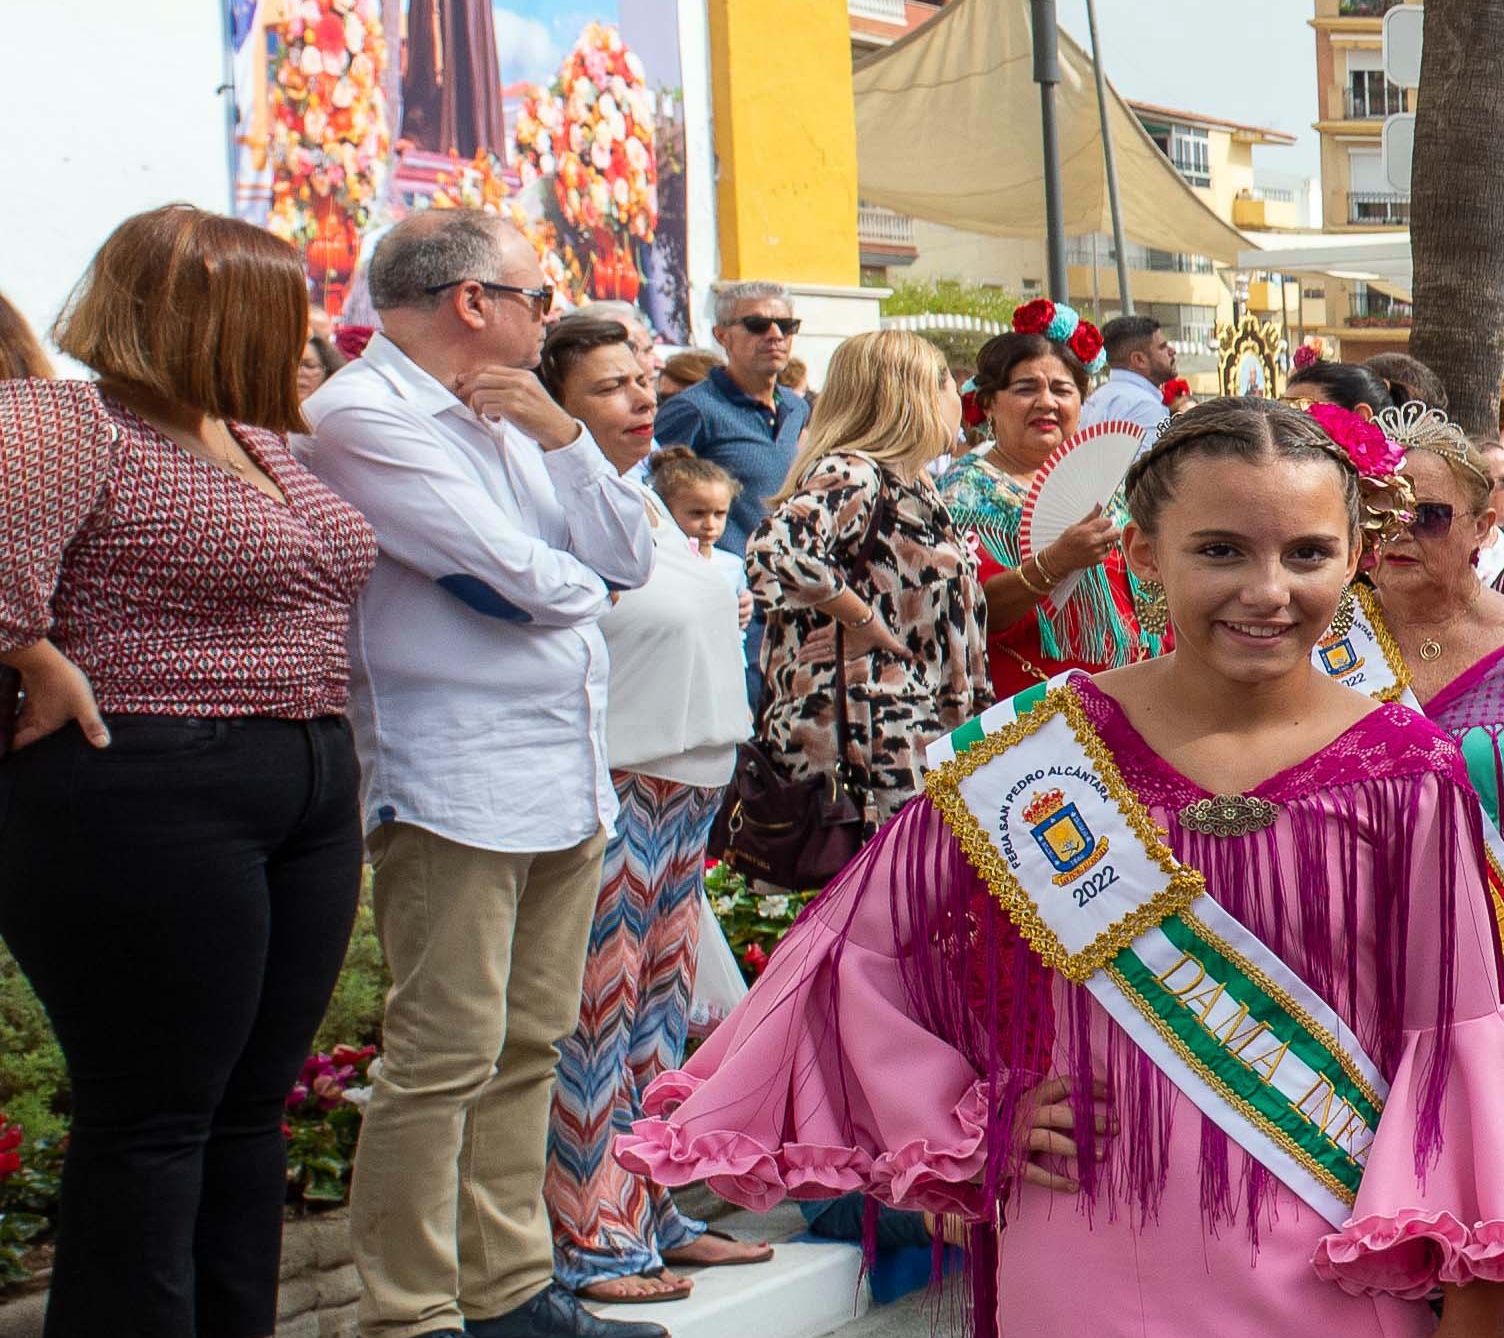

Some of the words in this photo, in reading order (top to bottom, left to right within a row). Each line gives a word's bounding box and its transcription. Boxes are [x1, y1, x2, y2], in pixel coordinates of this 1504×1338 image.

[1005, 769, 1045, 804] PEDRO
[1047, 765, 1110, 803] ALCÁNTARA
[999, 805, 1011, 831] SAN
[1000, 833, 1021, 870] FERIA
[1072, 865, 1121, 908] 2022
[1151, 949, 1291, 1088] DAMA
